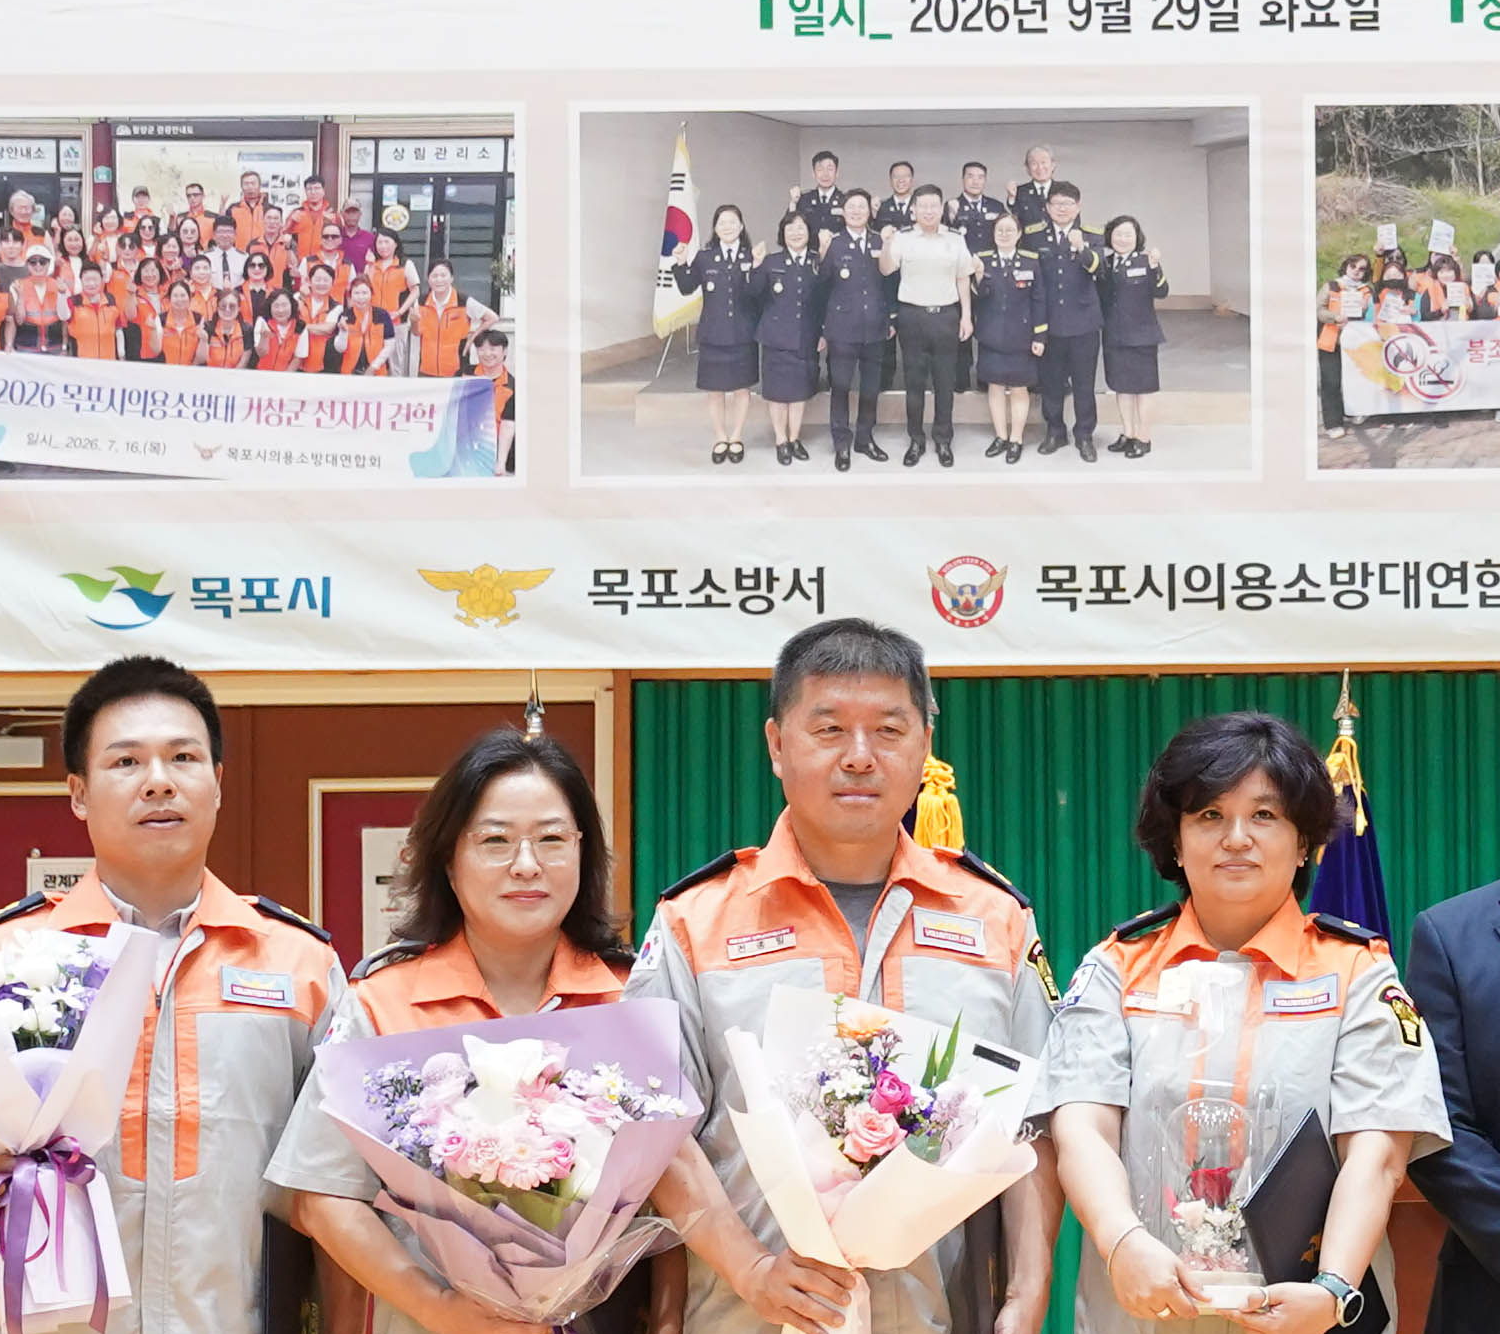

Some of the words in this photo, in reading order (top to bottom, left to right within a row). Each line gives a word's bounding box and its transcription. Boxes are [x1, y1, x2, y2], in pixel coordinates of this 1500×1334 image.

[61, 382, 236, 424] 목포시의용소방대
[189, 574, 333, 620] 목포시
[587, 564, 827, 616] 목포소방서
